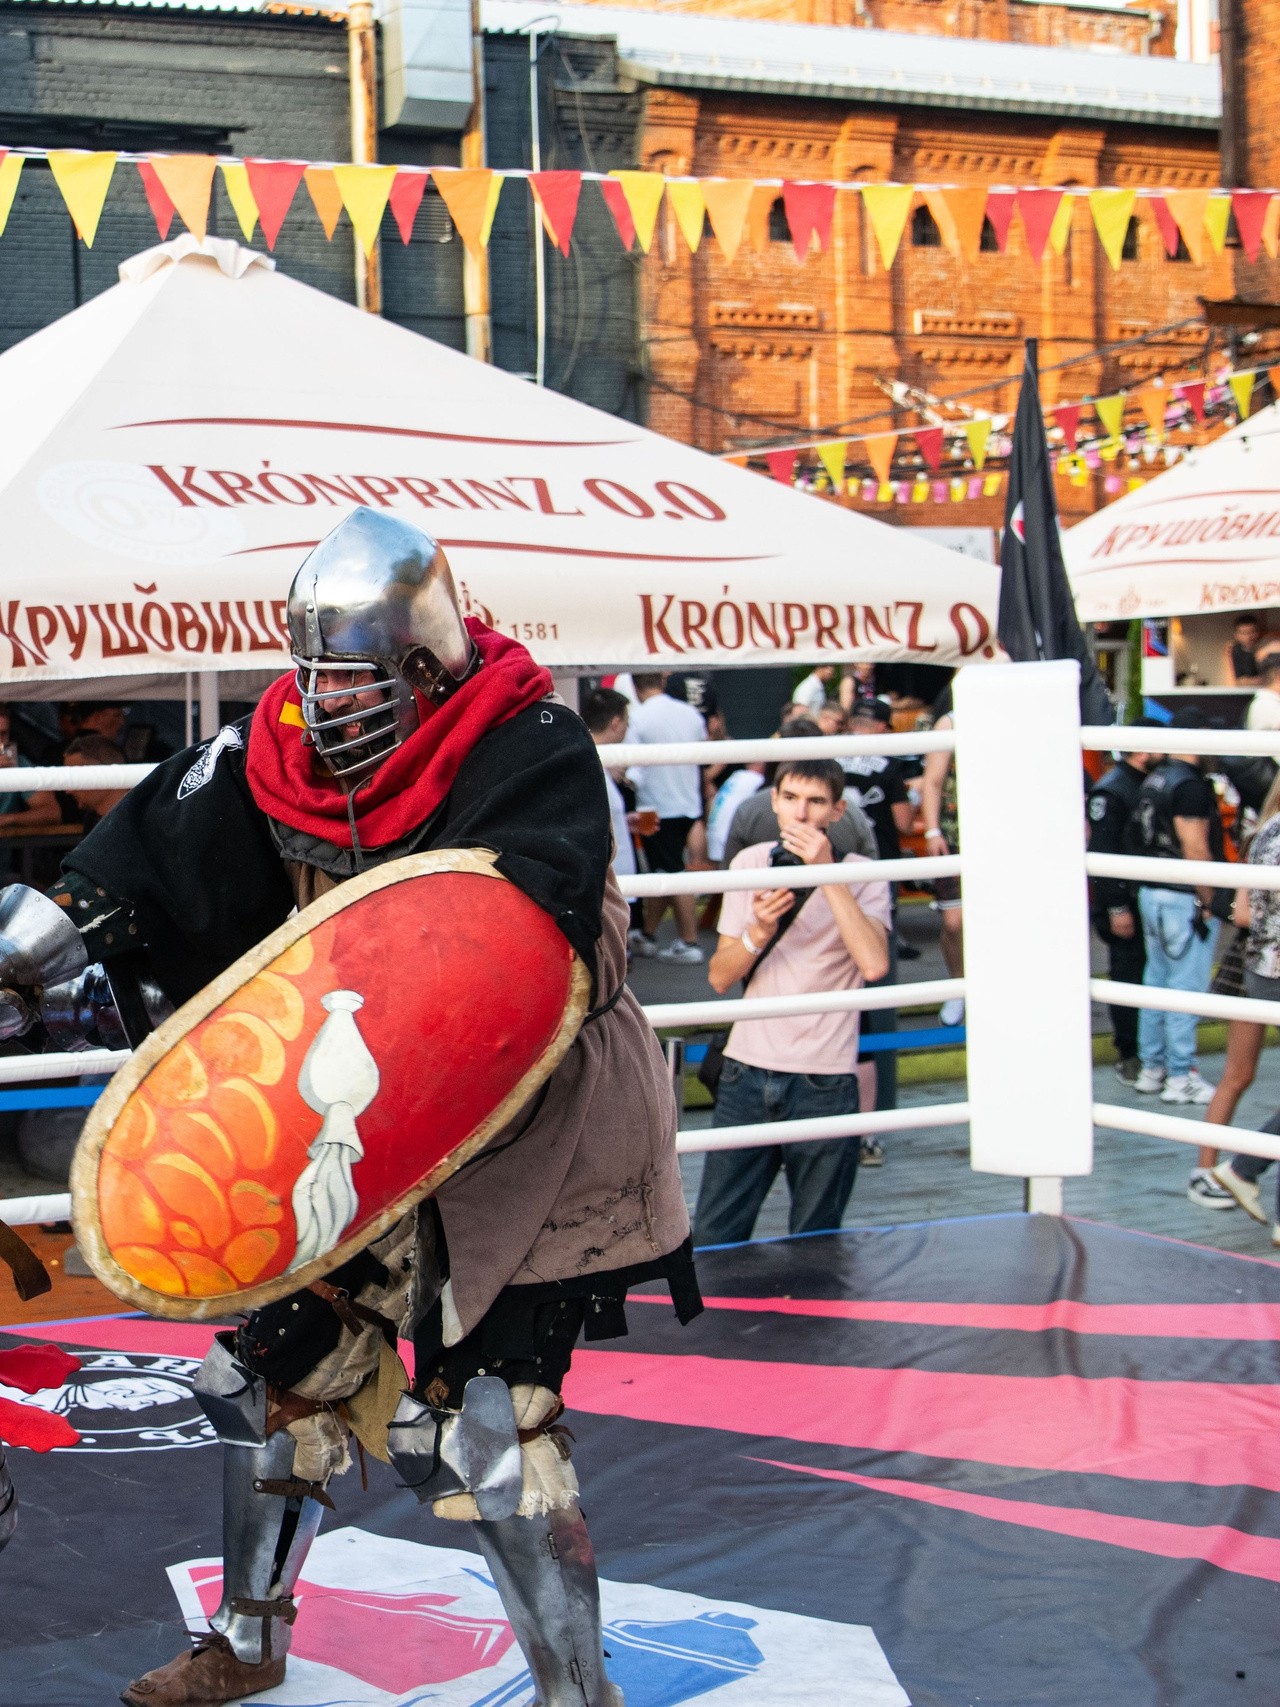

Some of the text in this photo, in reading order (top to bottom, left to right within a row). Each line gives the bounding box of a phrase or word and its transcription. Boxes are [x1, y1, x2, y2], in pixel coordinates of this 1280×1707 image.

[141, 460, 586, 517] KRÓNPRINZ
[582, 478, 727, 522] 0.0
[511, 622, 559, 641] 1581
[637, 584, 1006, 660] KRÓNPRINZ 0.
